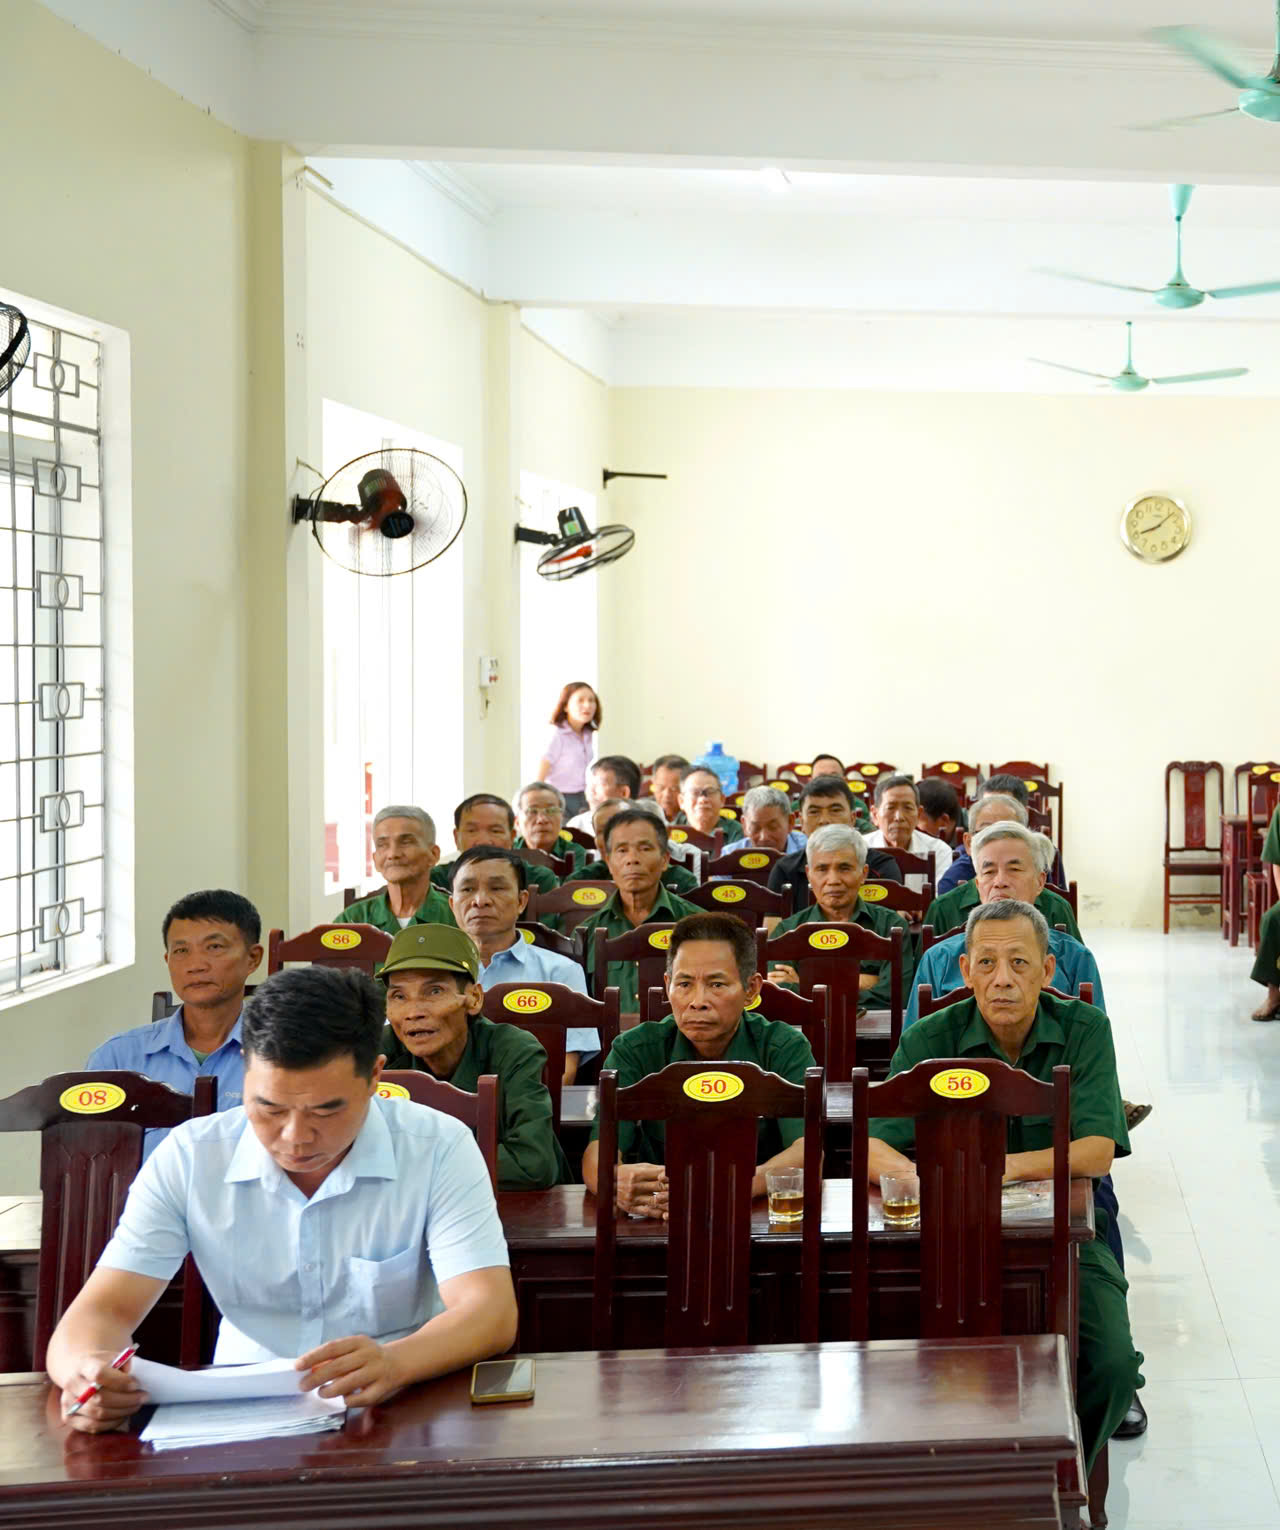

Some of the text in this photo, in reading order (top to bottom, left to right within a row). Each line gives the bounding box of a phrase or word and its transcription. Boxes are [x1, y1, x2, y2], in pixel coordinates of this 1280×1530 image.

[721, 889, 737, 899] 45
[863, 887, 878, 898] 27
[332, 934, 350, 945] 86
[819, 934, 838, 945] 05
[516, 995, 538, 1008] 66
[700, 1079, 727, 1095] 50
[947, 1075, 973, 1091] 56
[78, 1089, 108, 1107] 08
